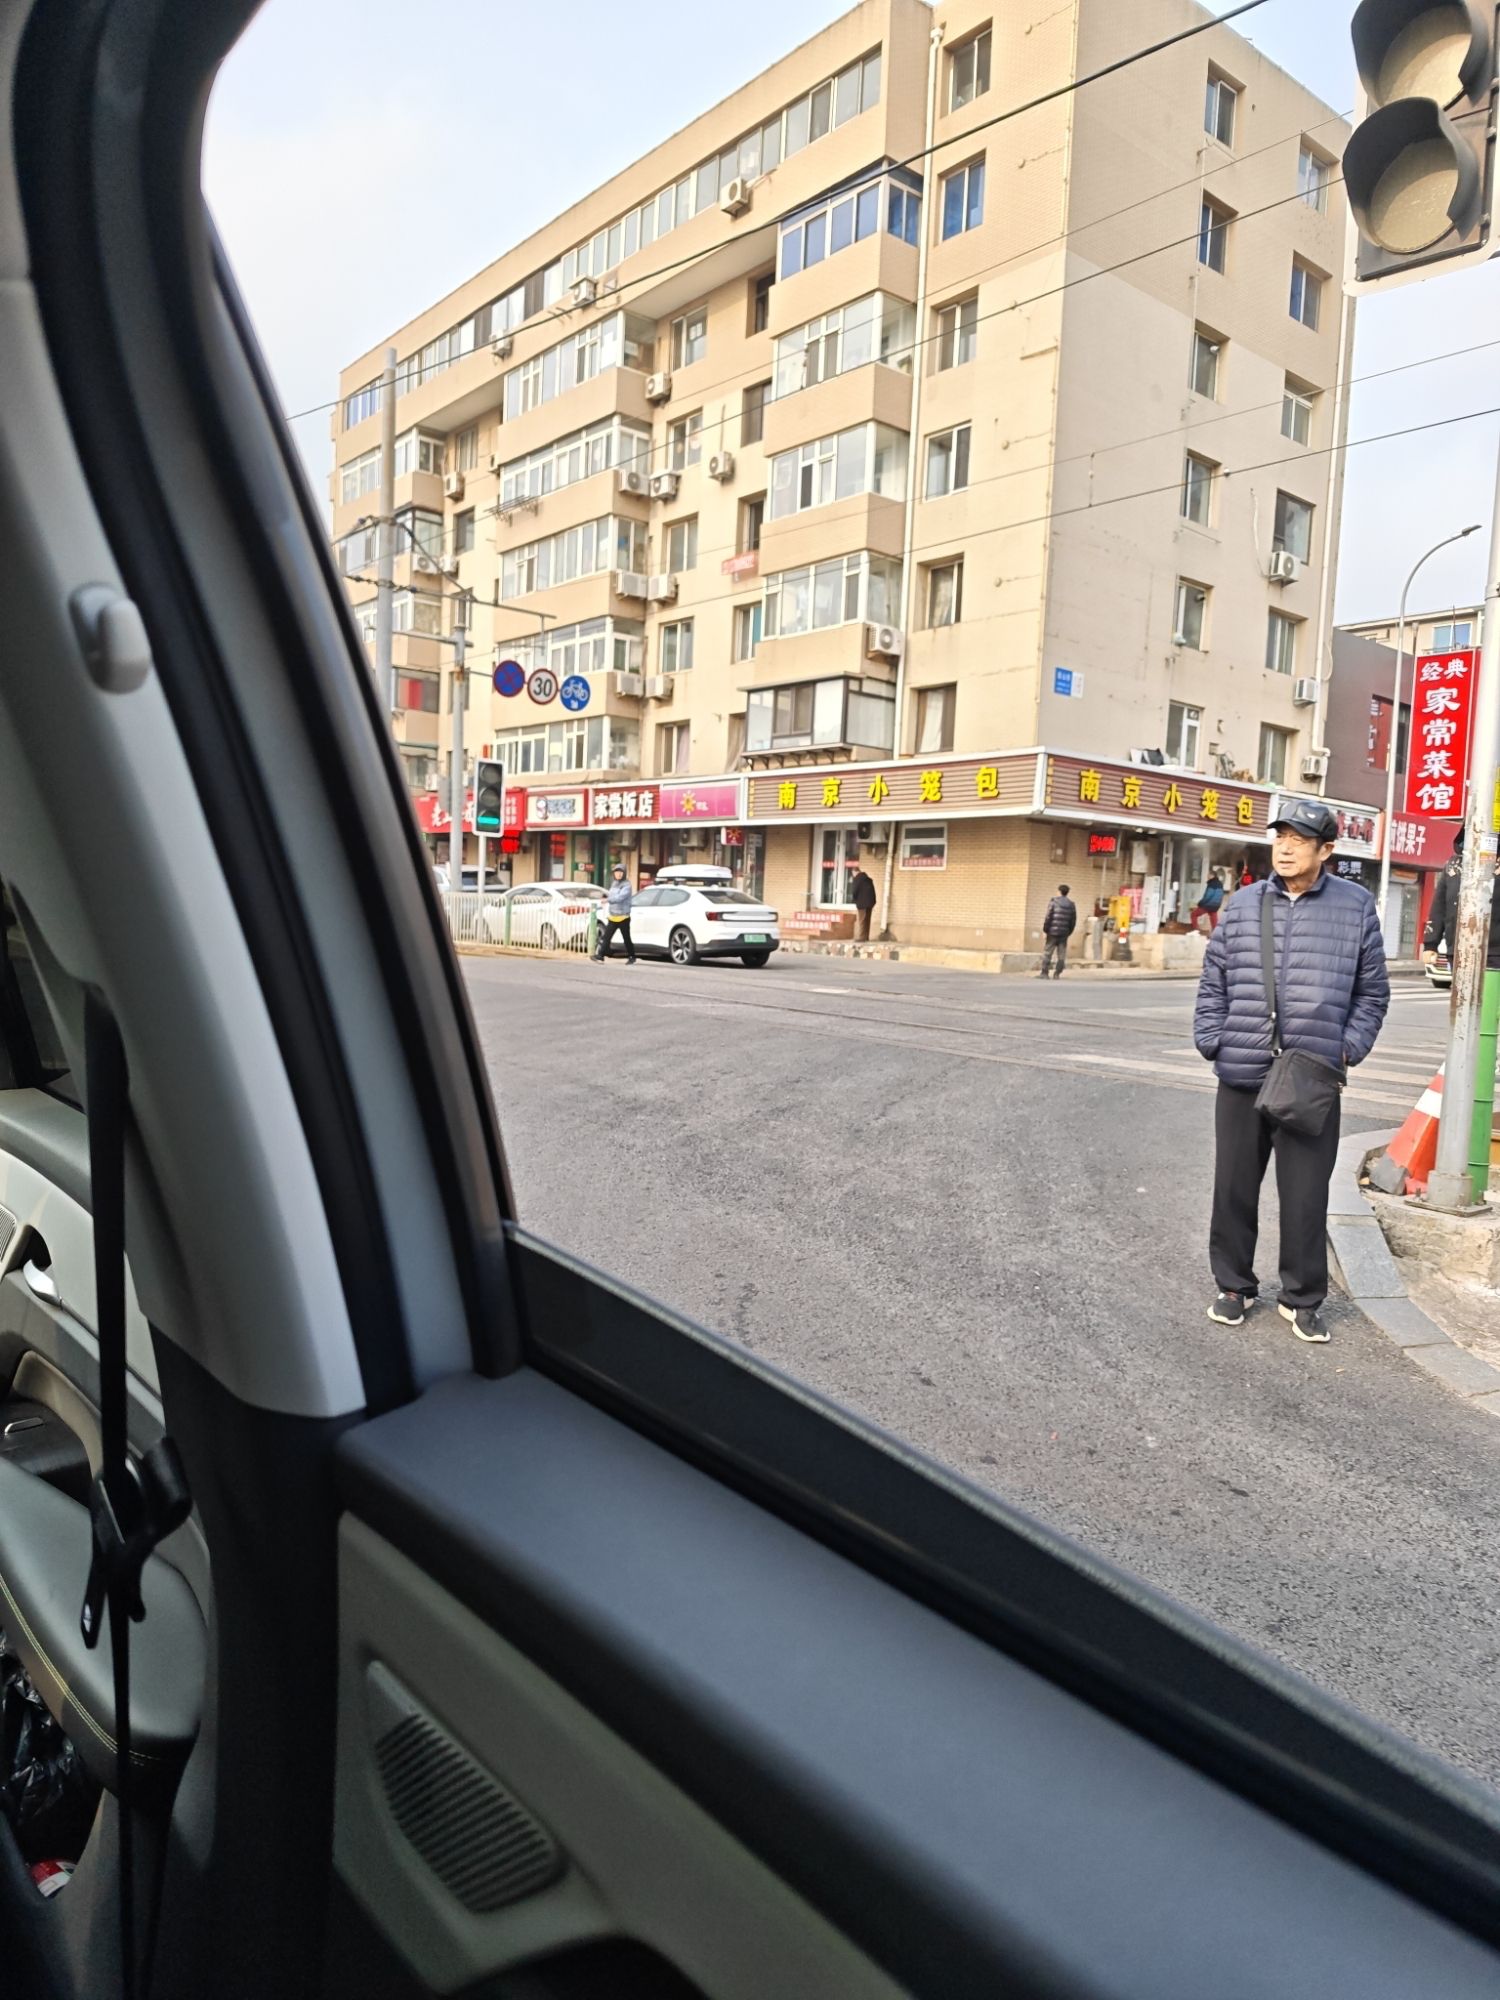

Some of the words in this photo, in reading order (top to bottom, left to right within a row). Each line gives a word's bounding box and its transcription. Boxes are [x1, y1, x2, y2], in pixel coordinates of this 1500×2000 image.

[1419, 658, 1469, 682] 经典
[533, 676, 553, 697] 30
[1415, 686, 1461, 811] 家常菜馆
[778, 766, 1000, 809] 南京小笼包
[1078, 768, 1255, 826] 南京小笼包
[594, 790, 655, 820] 家常饭店
[1337, 860, 1363, 874] 彩票
